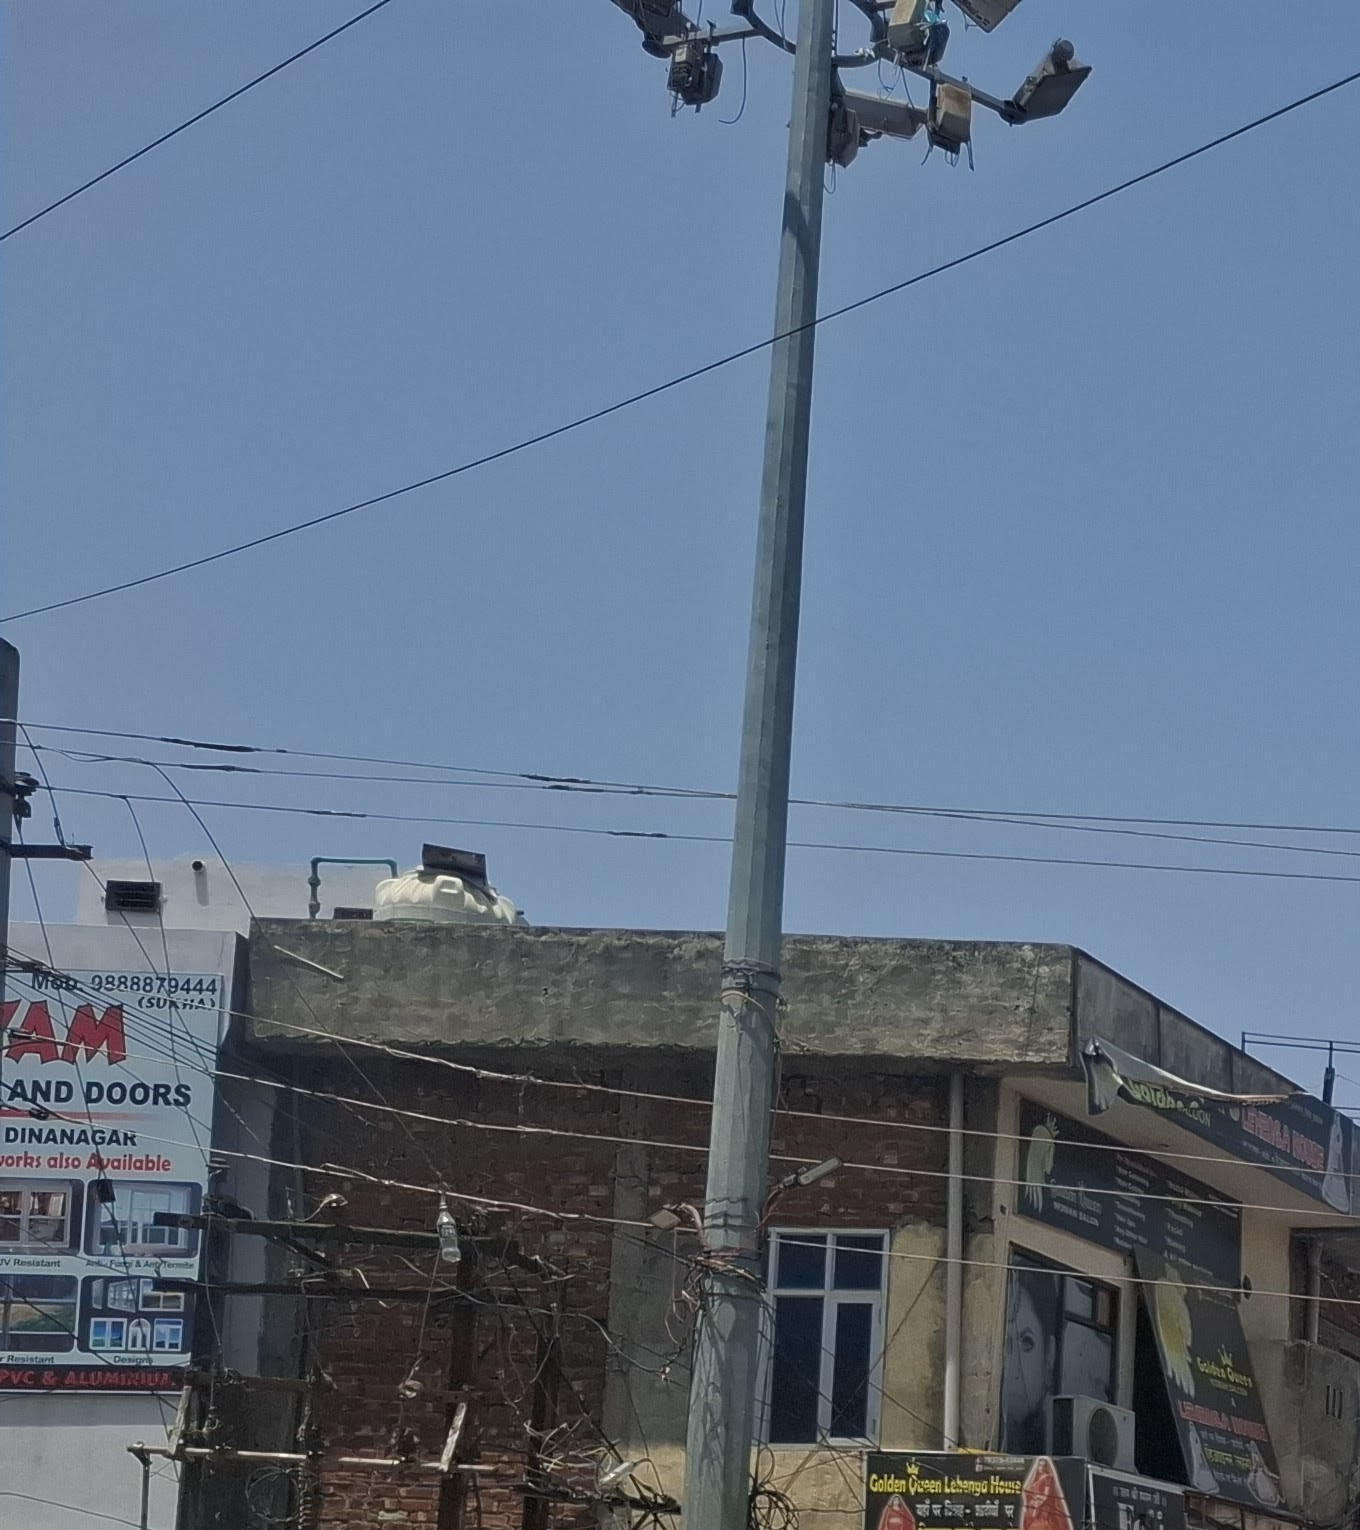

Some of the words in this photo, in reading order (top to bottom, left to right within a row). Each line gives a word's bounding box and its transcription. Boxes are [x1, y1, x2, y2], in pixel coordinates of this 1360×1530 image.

[91, 974, 218, 996] 9888879444
[8, 1079, 74, 1103] AND
[85, 1081, 192, 1107] DOORS
[5, 1127, 137, 1146] DINANAGAR
[46, 1152, 81, 1169] also
[86, 1153, 171, 1172] Available
[14, 1258, 60, 1268] Resistant
[7, 1355, 55, 1365] Resistant
[870, 1473, 905, 1493] Golden
[909, 1474, 942, 1495] Queen
[944, 1476, 988, 1496] Lehenga
[990, 1476, 1023, 1494] House
